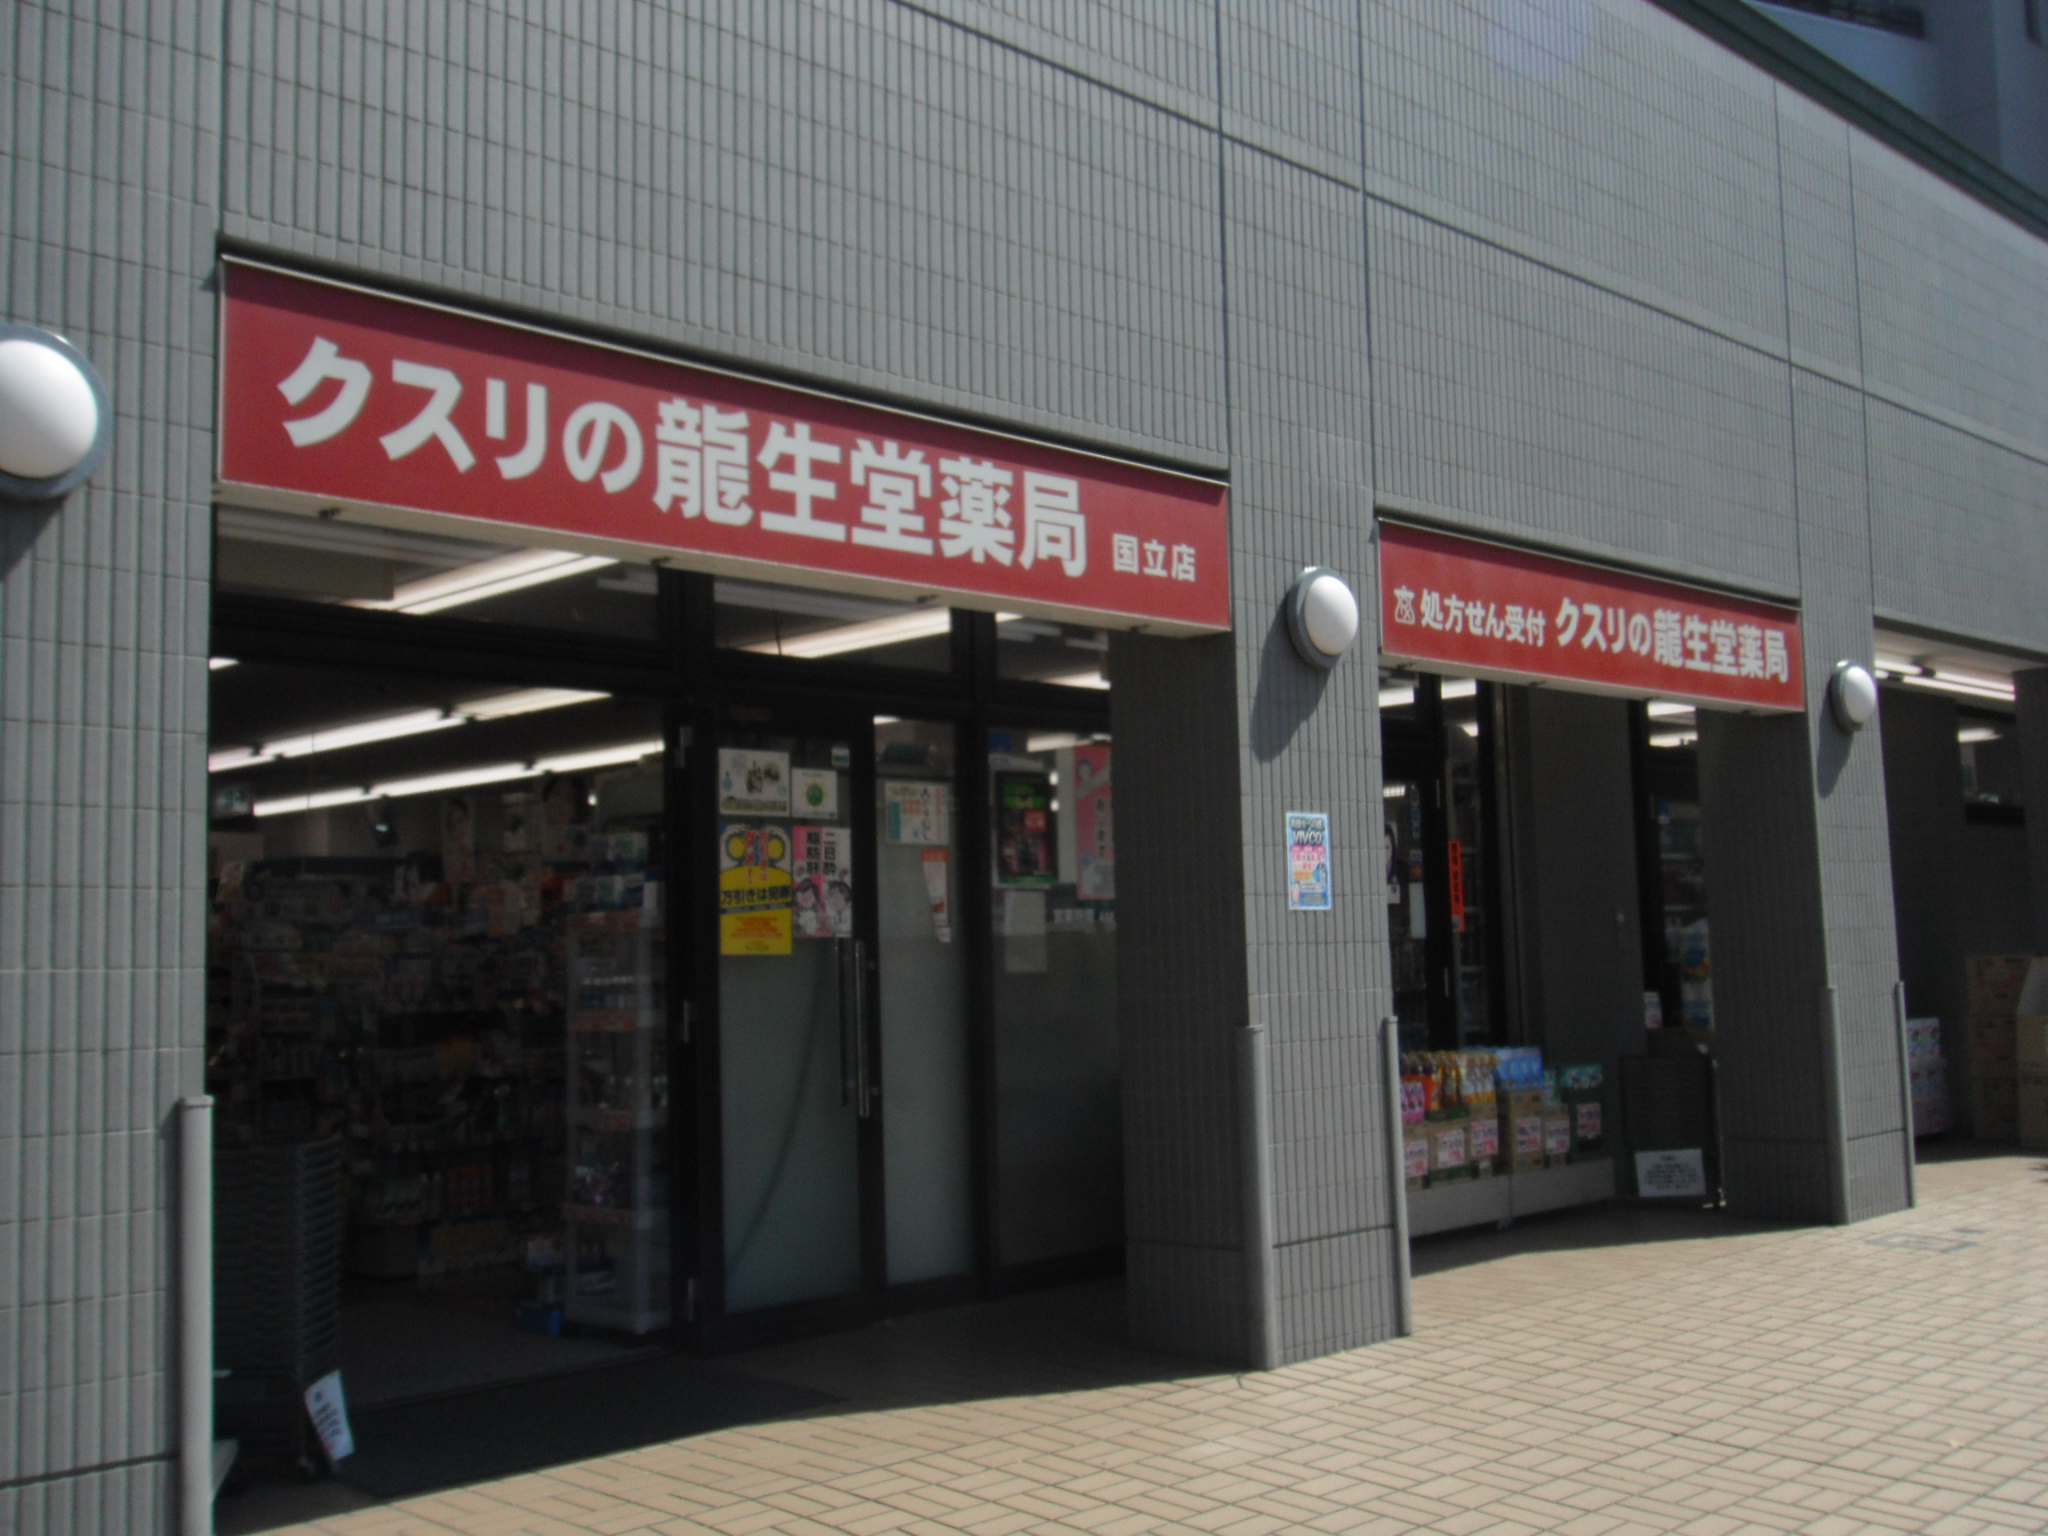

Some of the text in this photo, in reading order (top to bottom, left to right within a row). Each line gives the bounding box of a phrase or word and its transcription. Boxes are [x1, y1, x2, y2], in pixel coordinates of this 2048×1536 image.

[278, 337, 1197, 584] クスリの龍生堂薬局 国立店
[1421, 589, 1789, 684] 処方せん受付 クスリの龍生堂薬局
